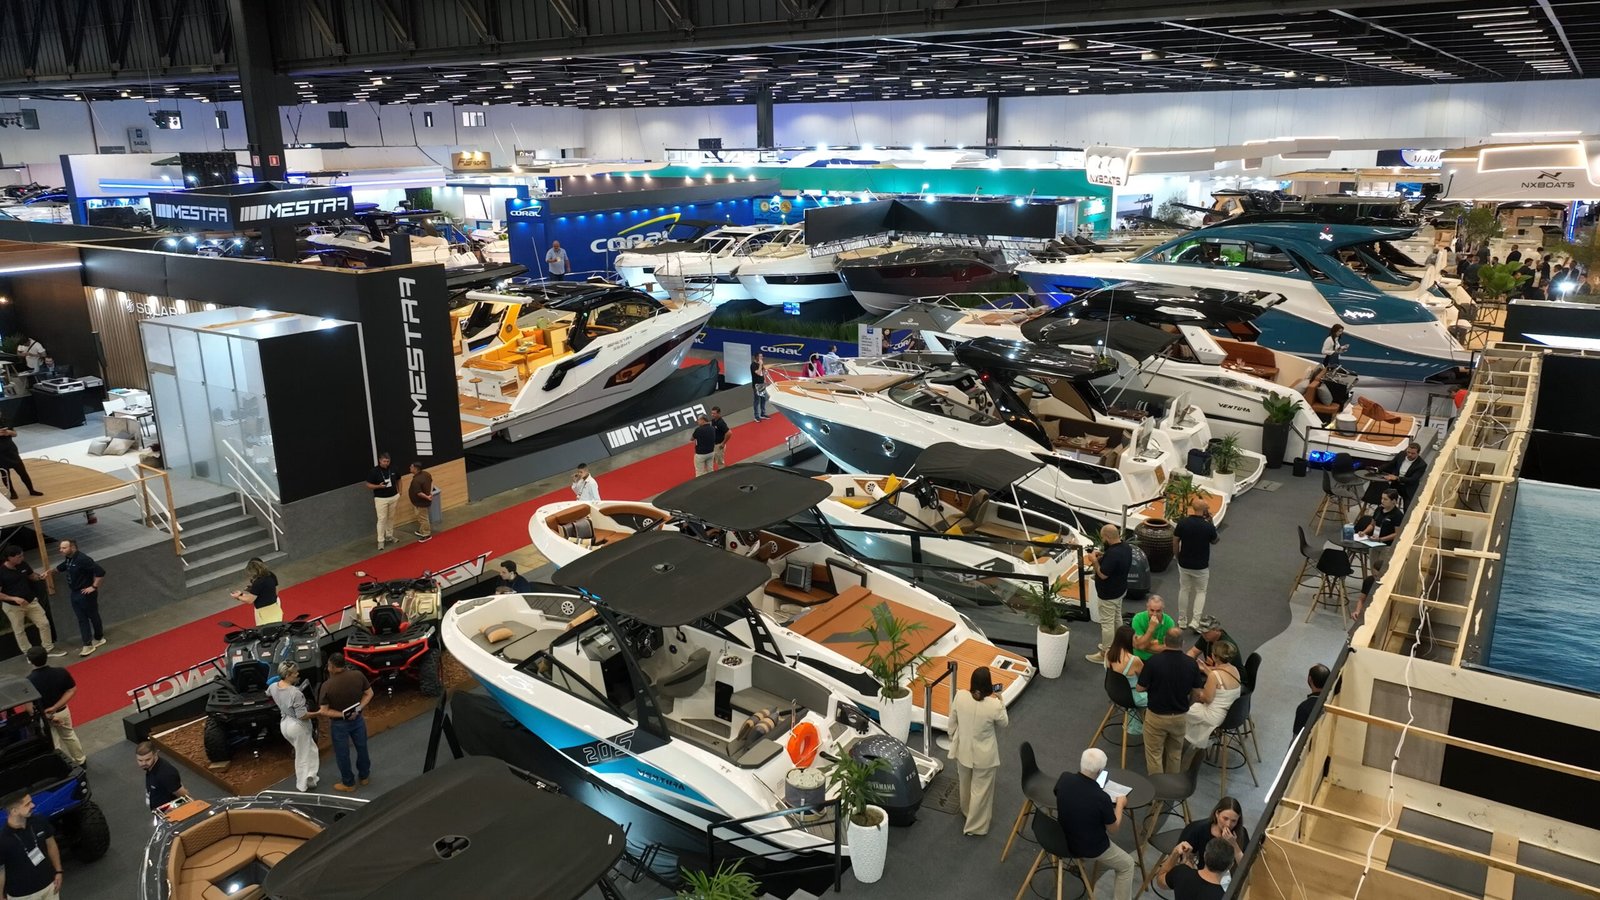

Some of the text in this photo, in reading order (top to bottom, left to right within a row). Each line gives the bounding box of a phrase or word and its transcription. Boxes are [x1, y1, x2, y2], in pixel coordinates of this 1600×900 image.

[1412, 154, 1440, 163] MARI
[1089, 174, 1121, 186] NXBOATS
[1521, 181, 1575, 189] NXBOATS
[760, 344, 802, 356] CORAL
[1218, 402, 1251, 413] VENTURA
[583, 730, 635, 764] 205
[637, 768, 686, 791] VENTURA
[872, 783, 896, 792] YAMAHA
